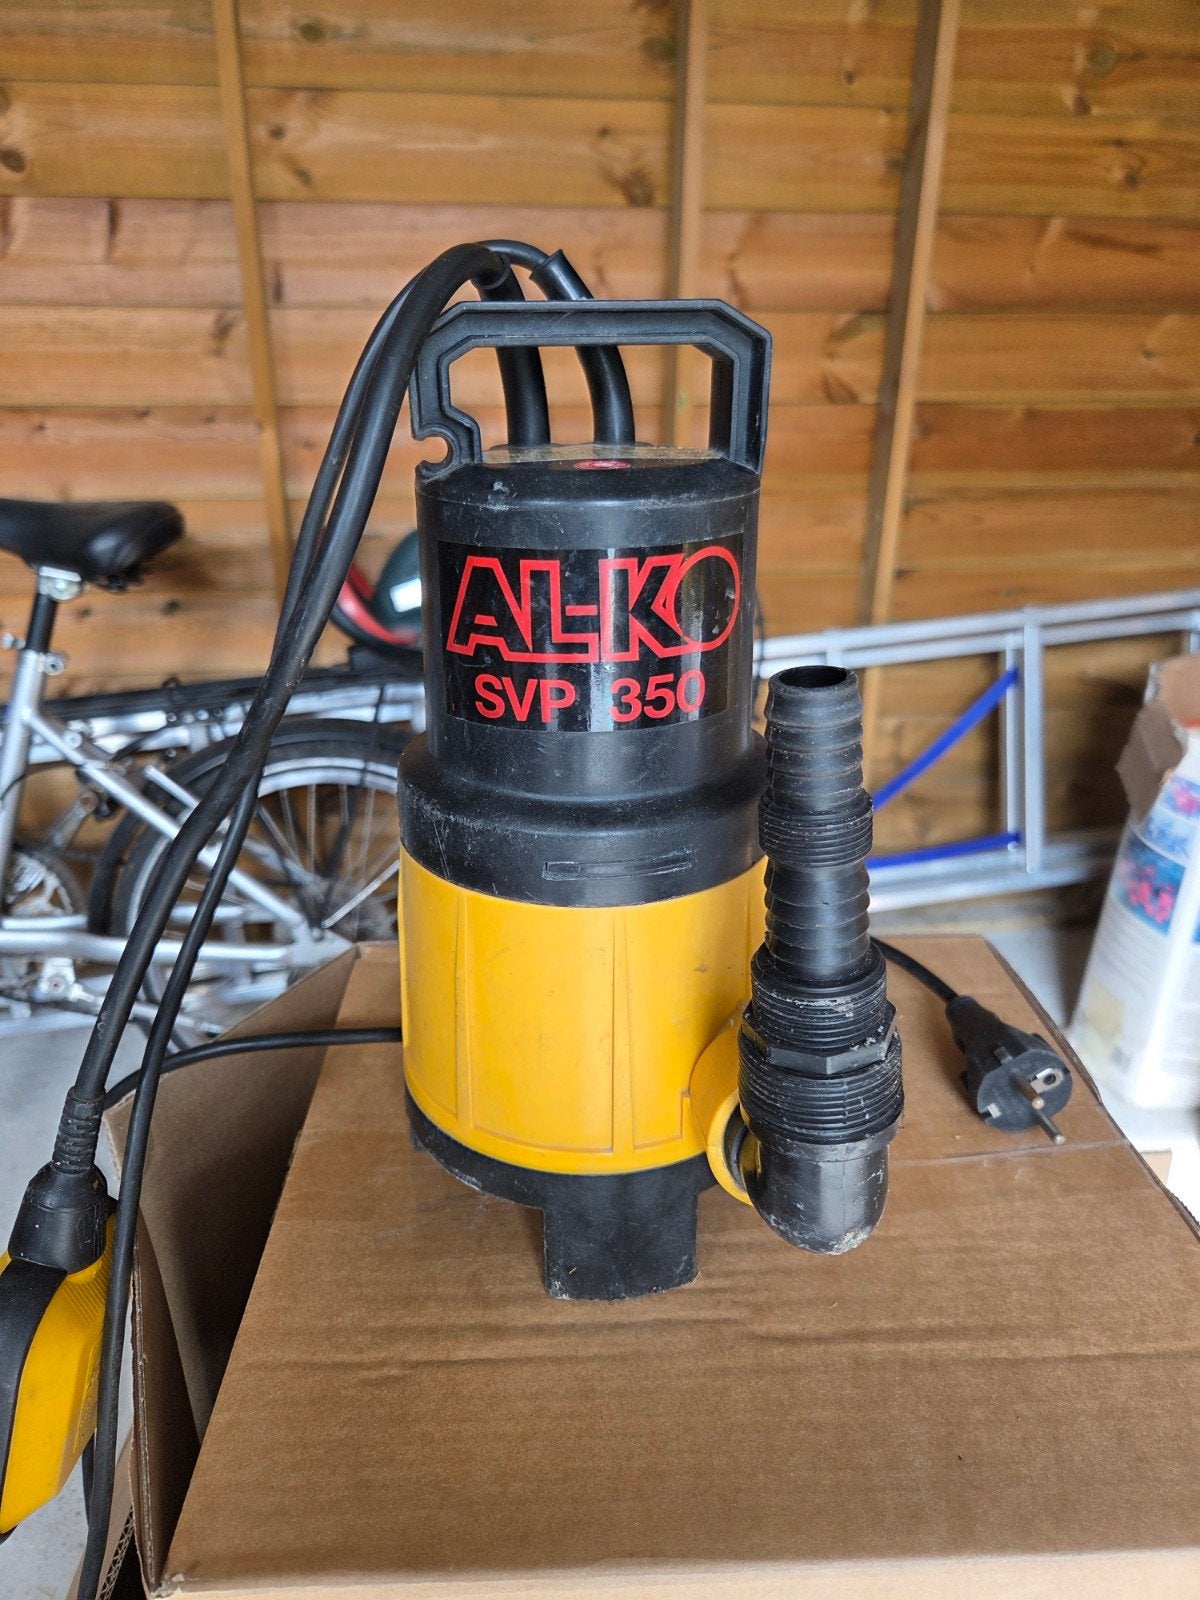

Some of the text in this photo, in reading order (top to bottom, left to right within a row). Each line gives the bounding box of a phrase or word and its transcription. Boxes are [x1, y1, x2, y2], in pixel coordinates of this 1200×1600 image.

[447, 546, 740, 663] AL-KO
[475, 670, 706, 722] SVP 350
